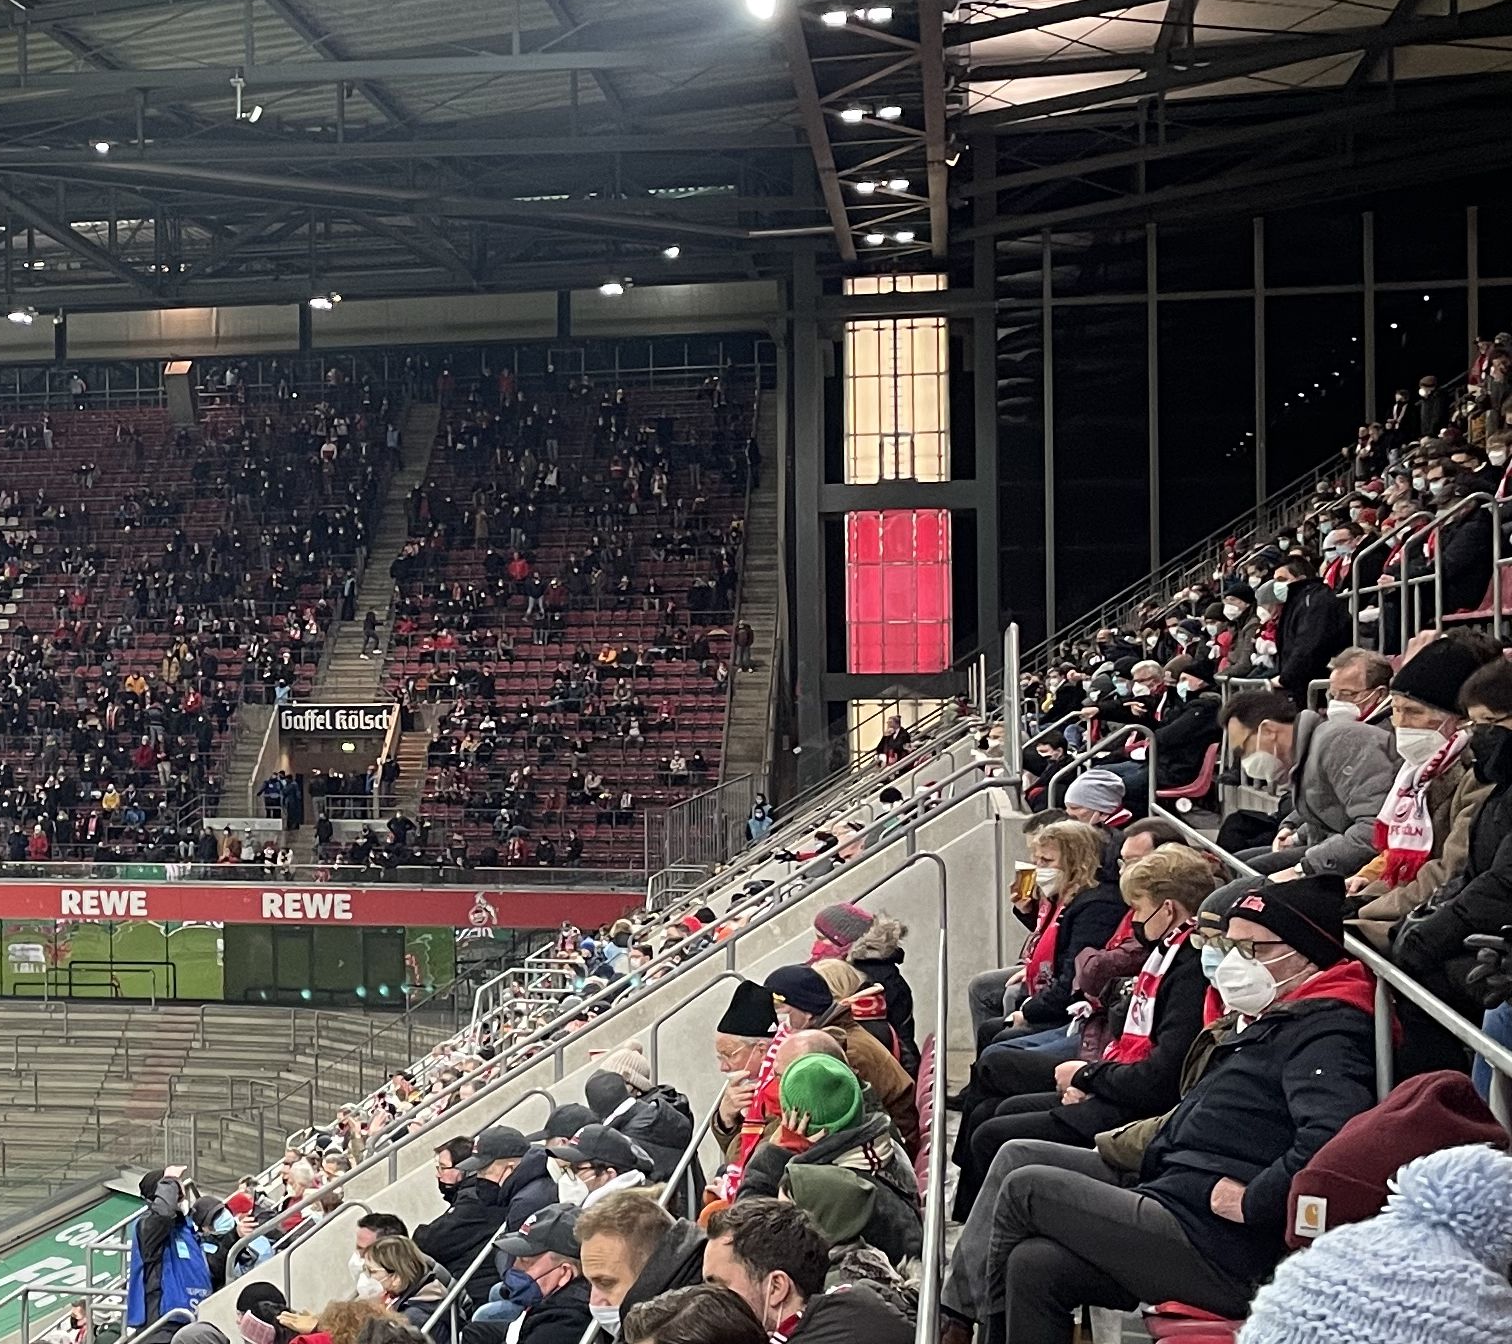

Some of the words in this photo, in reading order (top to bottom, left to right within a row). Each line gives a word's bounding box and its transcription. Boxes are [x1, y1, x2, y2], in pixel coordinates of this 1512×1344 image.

[281, 709, 332, 731] Gaffel
[60, 889, 148, 918] REWE
[261, 892, 353, 921] REWE
